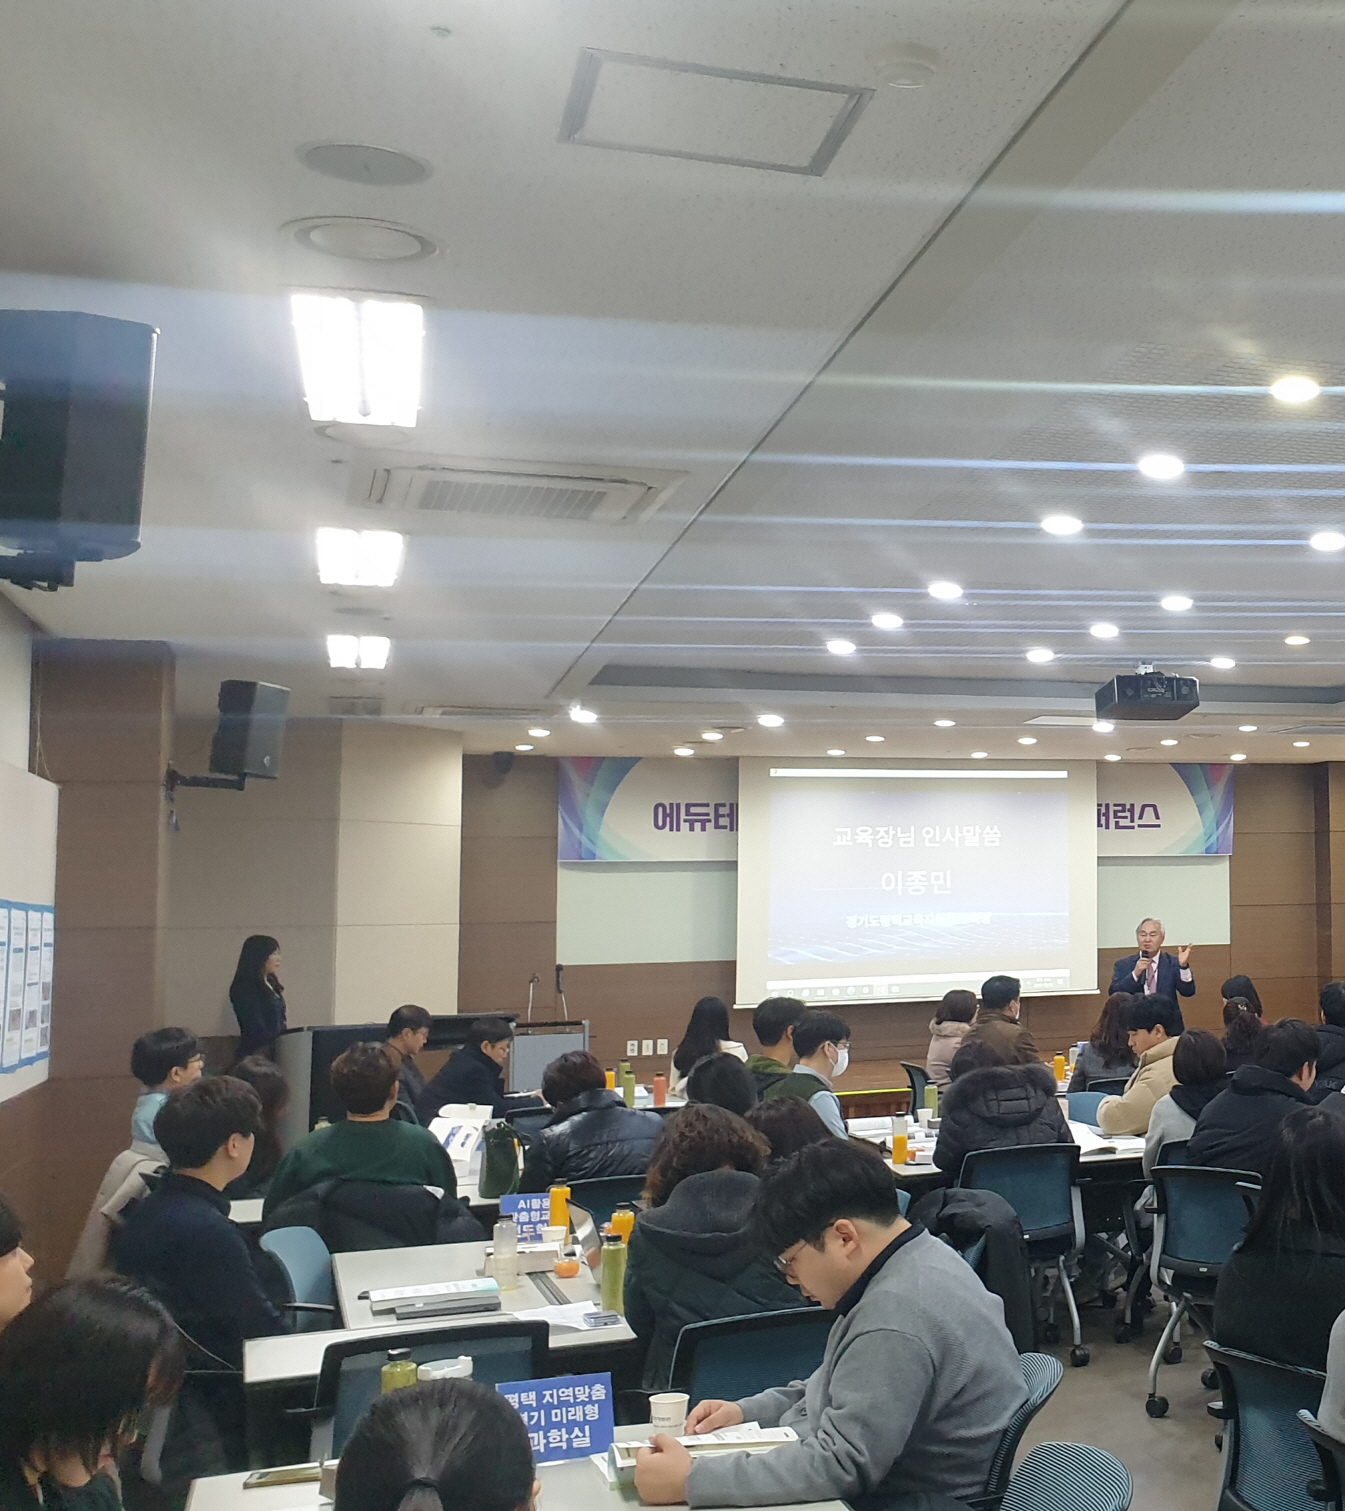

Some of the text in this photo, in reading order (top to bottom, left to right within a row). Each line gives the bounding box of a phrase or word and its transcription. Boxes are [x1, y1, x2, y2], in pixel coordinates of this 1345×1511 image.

[833, 825, 1002, 848] 교육장님 인사말씀
[881, 870, 952, 896] 이종민
[542, 1383, 607, 1405] 지역맞춤
[551, 1403, 599, 1424] 미래형
[528, 1425, 591, 1453] 과학실
